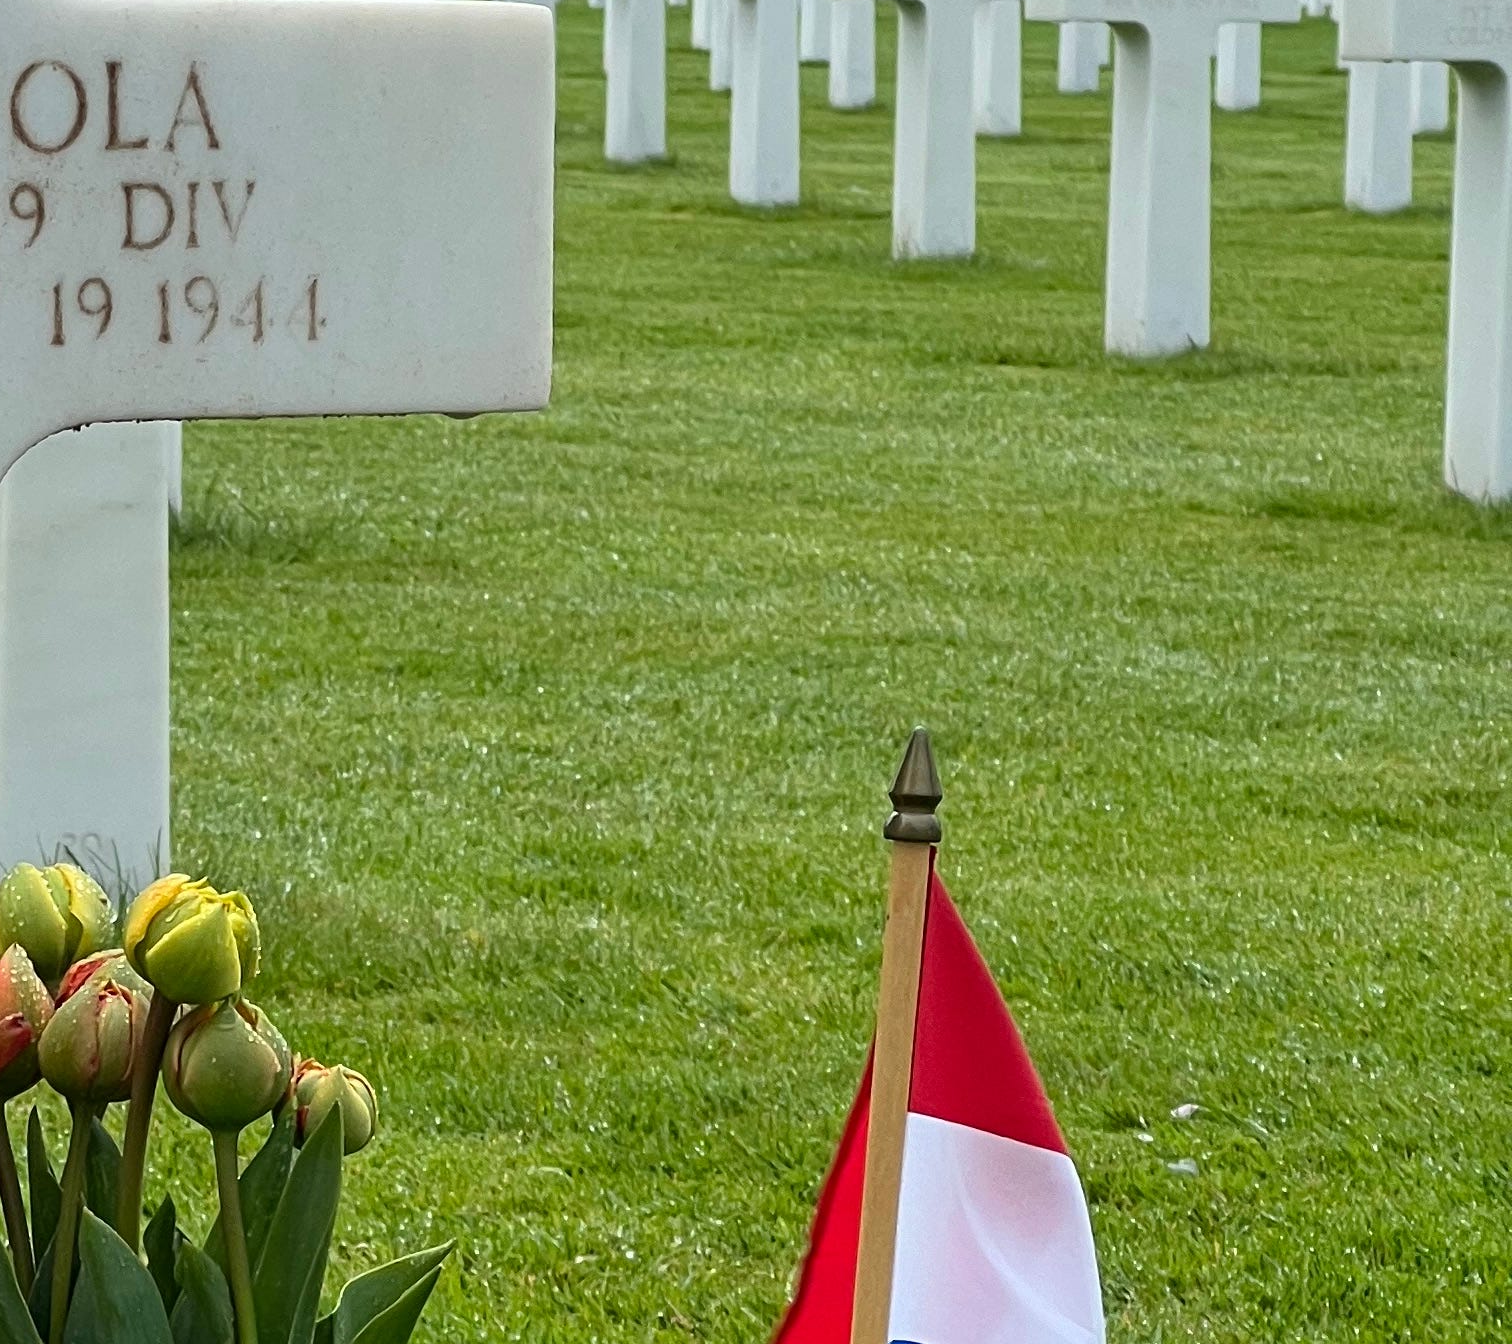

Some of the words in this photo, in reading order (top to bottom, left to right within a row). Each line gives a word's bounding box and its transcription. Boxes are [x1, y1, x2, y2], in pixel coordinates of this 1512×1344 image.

[120, 179, 257, 252] DIV
[50, 276, 113, 348] 19
[157, 274, 327, 345] 1944
